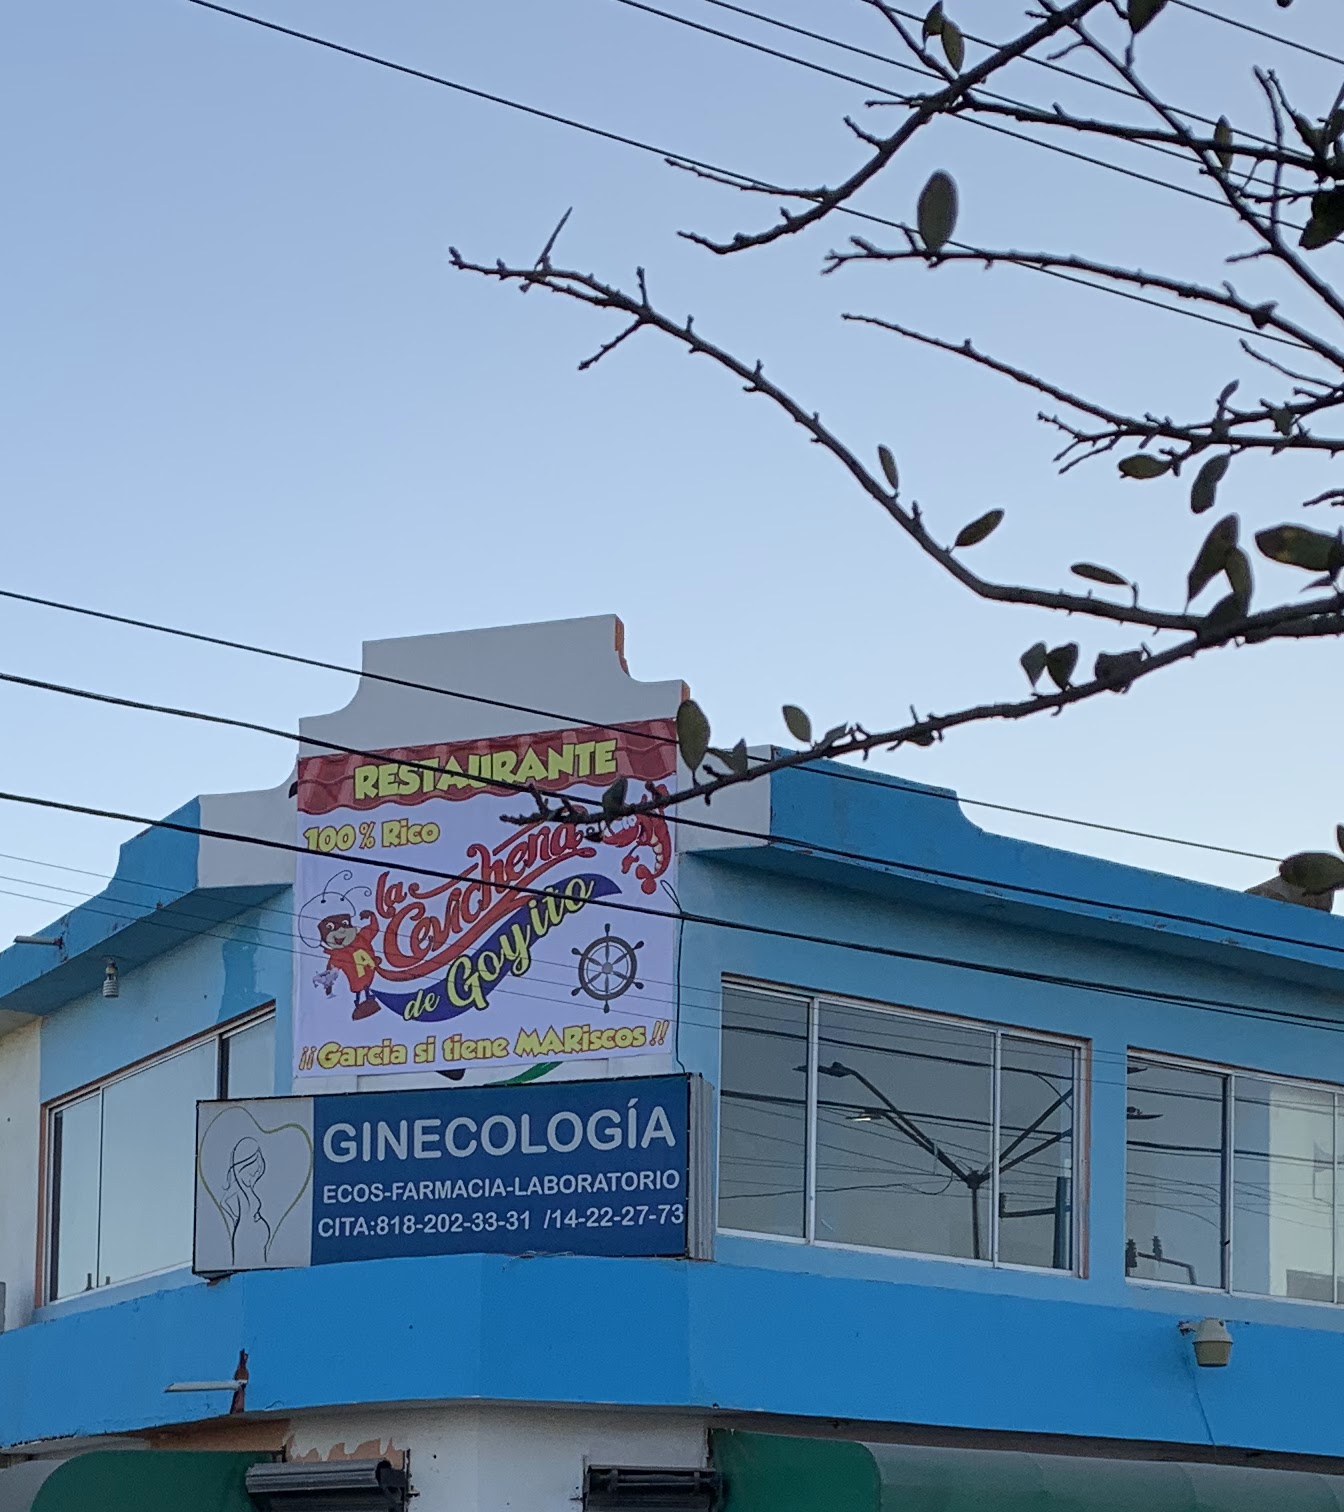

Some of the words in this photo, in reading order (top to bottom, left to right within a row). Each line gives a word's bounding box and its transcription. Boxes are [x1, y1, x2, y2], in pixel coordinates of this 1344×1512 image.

[354, 739, 617, 799] RESTAURANTE
[303, 825, 355, 853] 100
[381, 818, 441, 847] Rico
[403, 989, 441, 1020] de
[447, 877, 595, 1010] Goyito
[413, 1037, 436, 1065] si
[442, 1033, 508, 1062] tiene
[323, 1098, 676, 1163] GINECOLOGÍA
[324, 1169, 680, 1204] ECOS-FARMACIA-LABORATORIO
